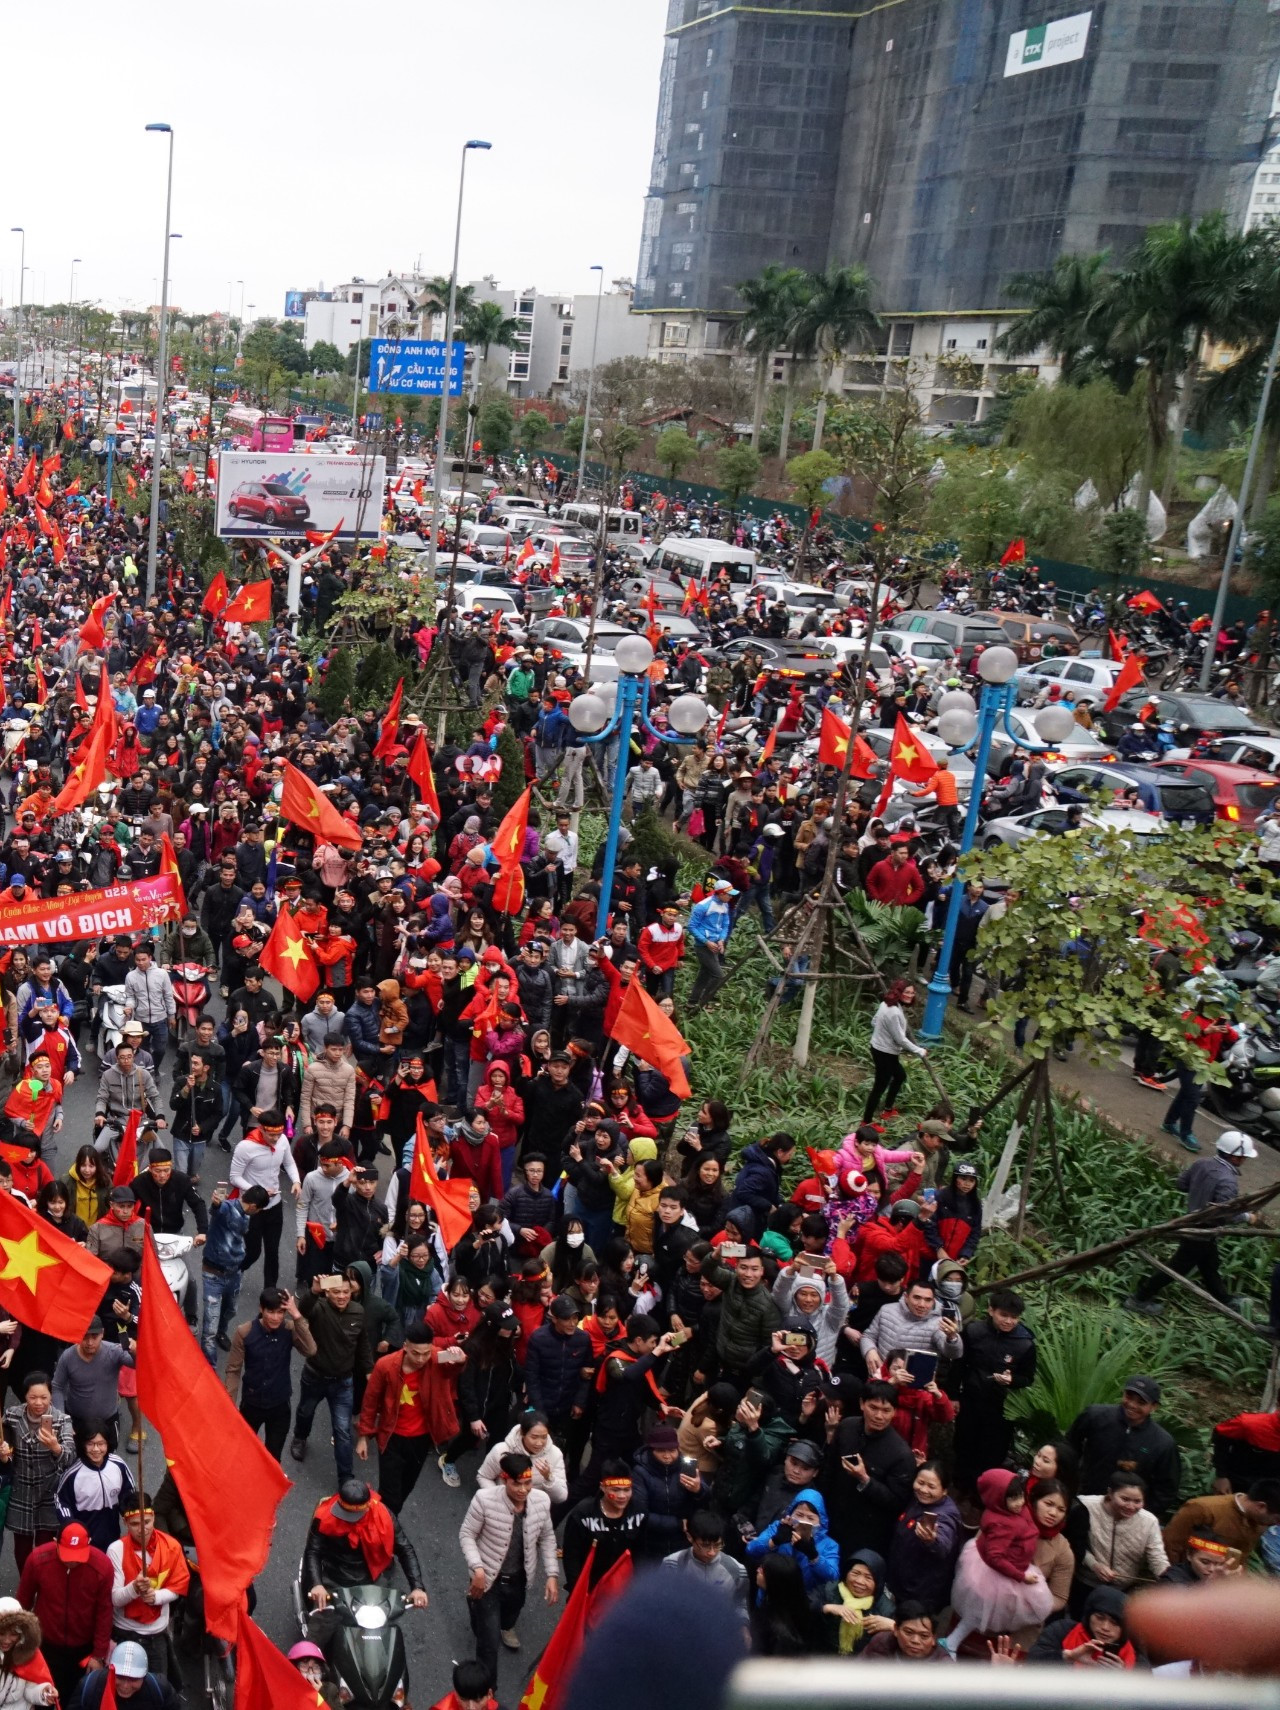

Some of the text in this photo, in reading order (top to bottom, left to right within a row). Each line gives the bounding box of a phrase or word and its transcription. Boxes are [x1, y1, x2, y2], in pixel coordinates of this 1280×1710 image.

[1047, 32, 1081, 52] project
[404, 346, 423, 355] ANH
[425, 346, 439, 358] NỘI
[407, 362, 424, 375] CẦU
[439, 380, 457, 390] TM
[104, 885, 128, 898] U23
[43, 914, 74, 938] VÔ
[78, 907, 133, 935] ĐỊCH
